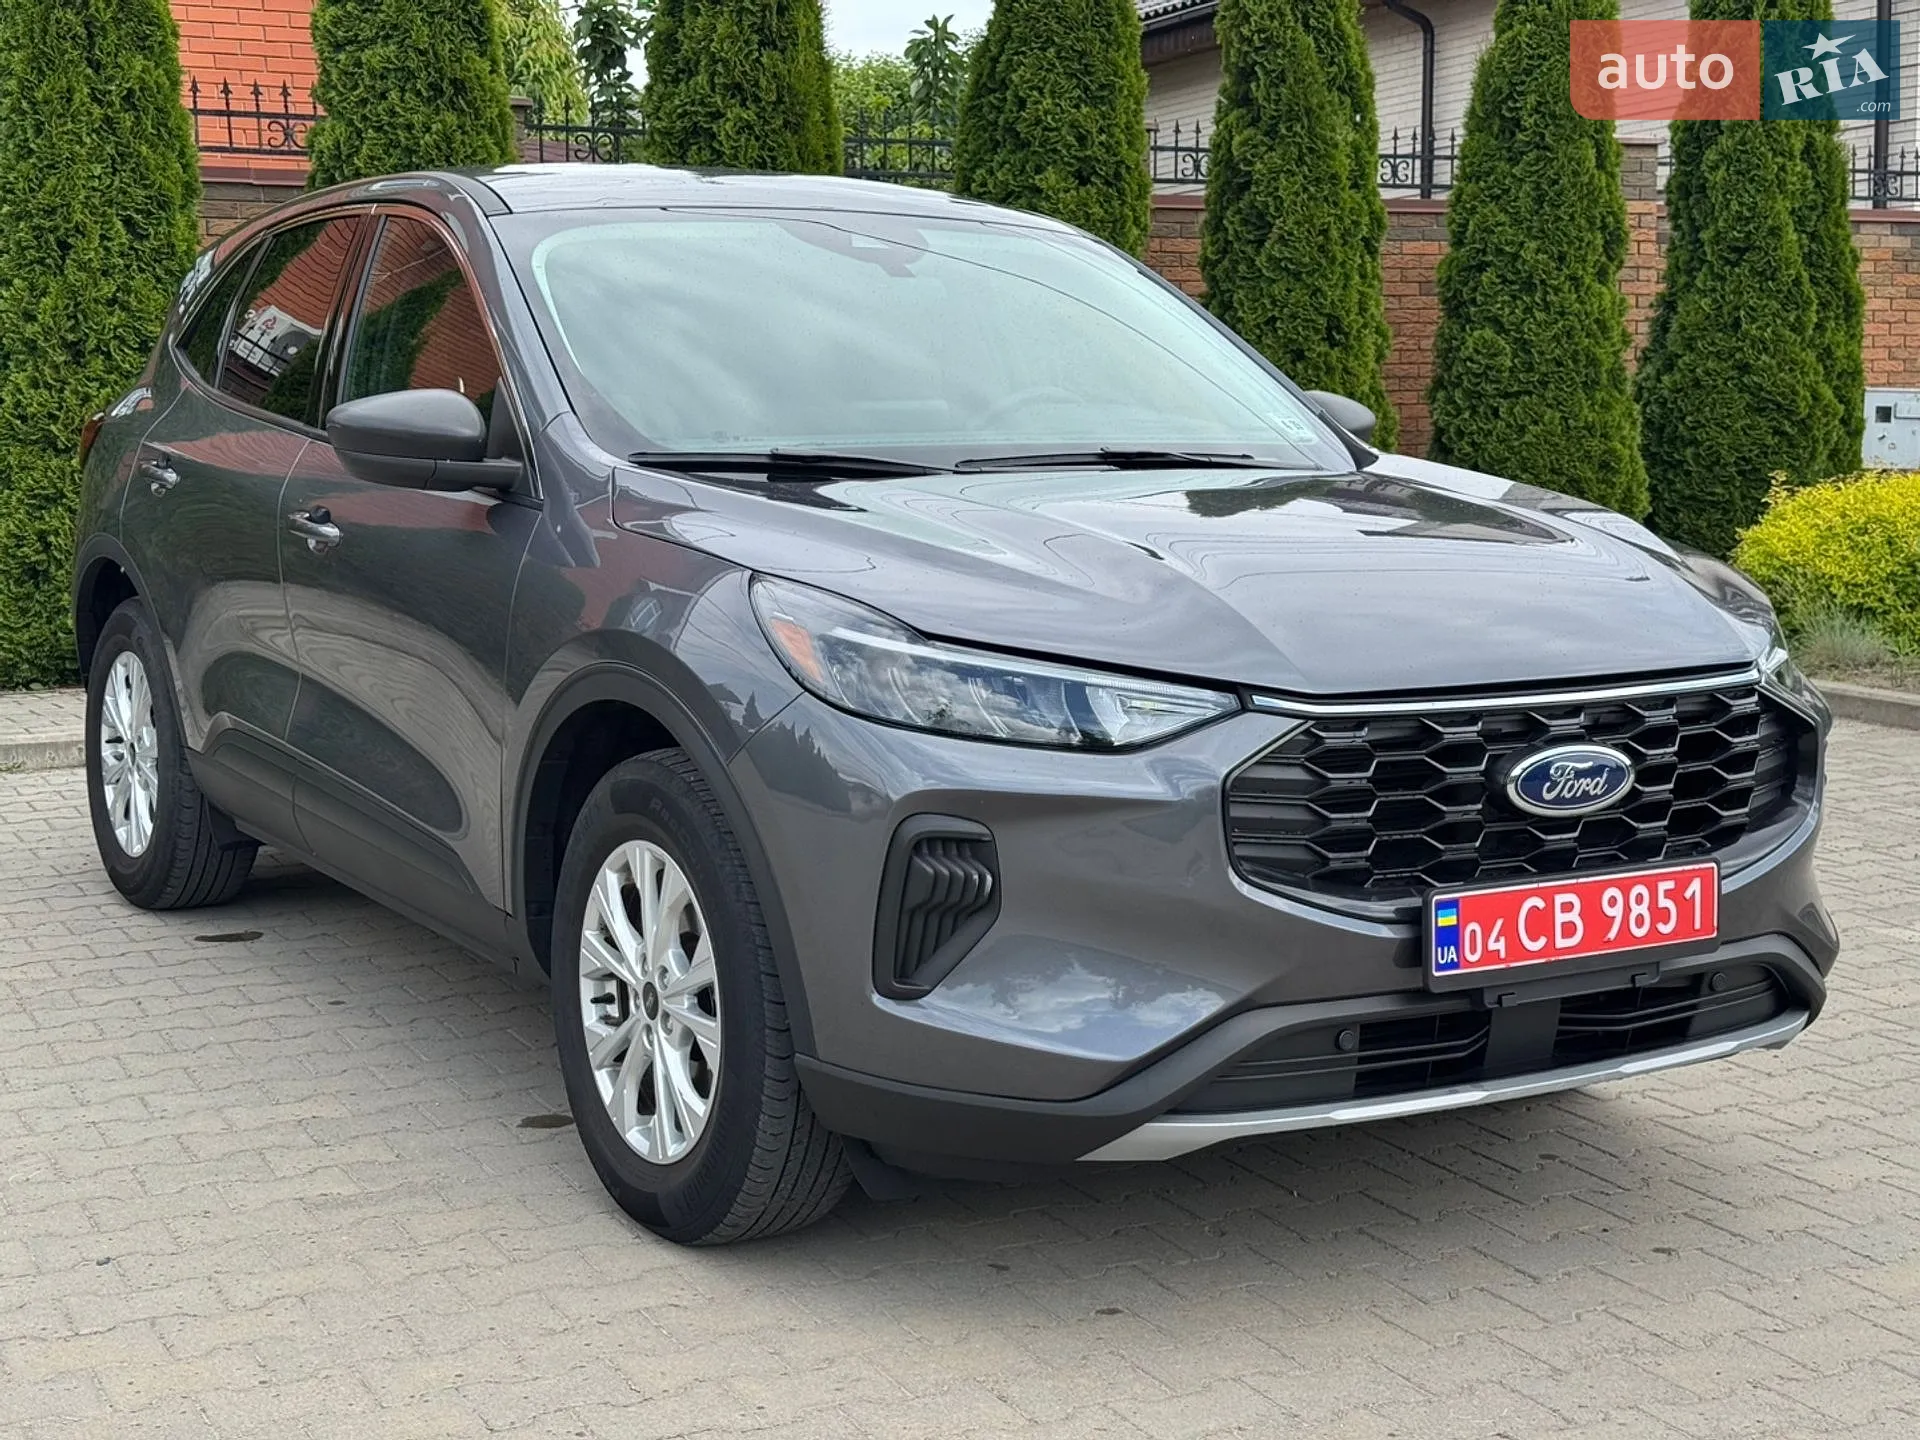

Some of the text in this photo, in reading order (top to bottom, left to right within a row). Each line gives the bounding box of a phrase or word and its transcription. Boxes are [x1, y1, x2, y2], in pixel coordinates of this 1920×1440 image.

[1542, 761, 1610, 801] Ford
[1463, 876, 1702, 964] 04 CB 9851
[1437, 945, 1459, 965] UA
